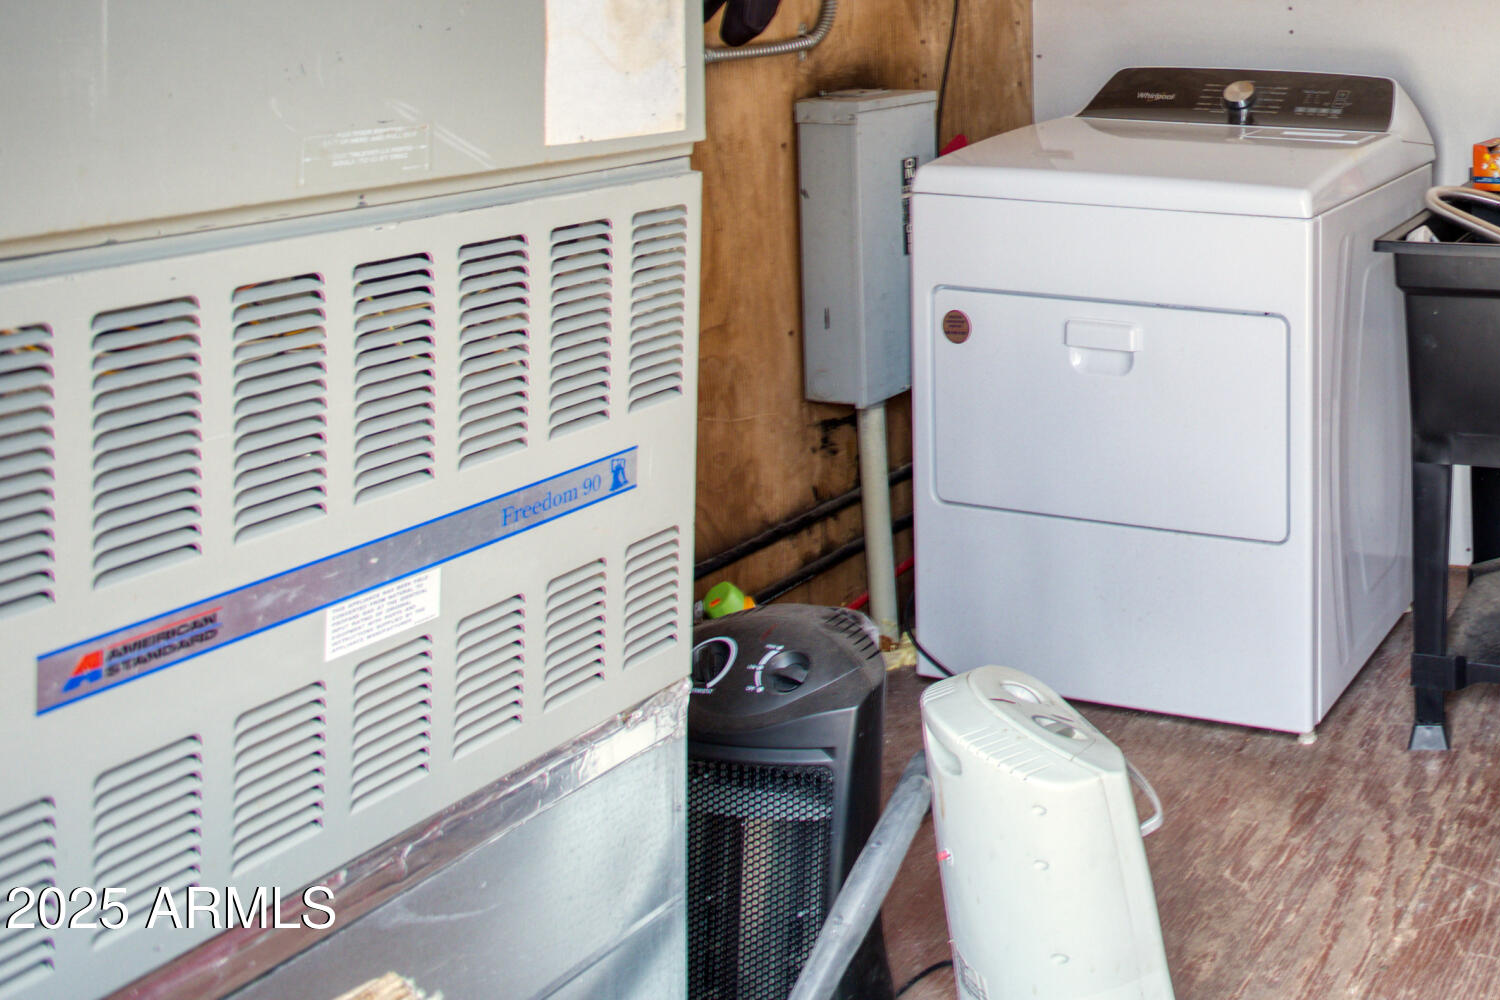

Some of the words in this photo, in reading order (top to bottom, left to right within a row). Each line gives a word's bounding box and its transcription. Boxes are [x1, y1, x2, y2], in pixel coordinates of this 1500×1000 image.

[1136, 91, 1176, 101] Whirlpool
[502, 487, 578, 527] Freedom
[582, 474, 602, 496] 90
[105, 628, 219, 677] STANDARD
[106, 613, 218, 660] AMERICAN
